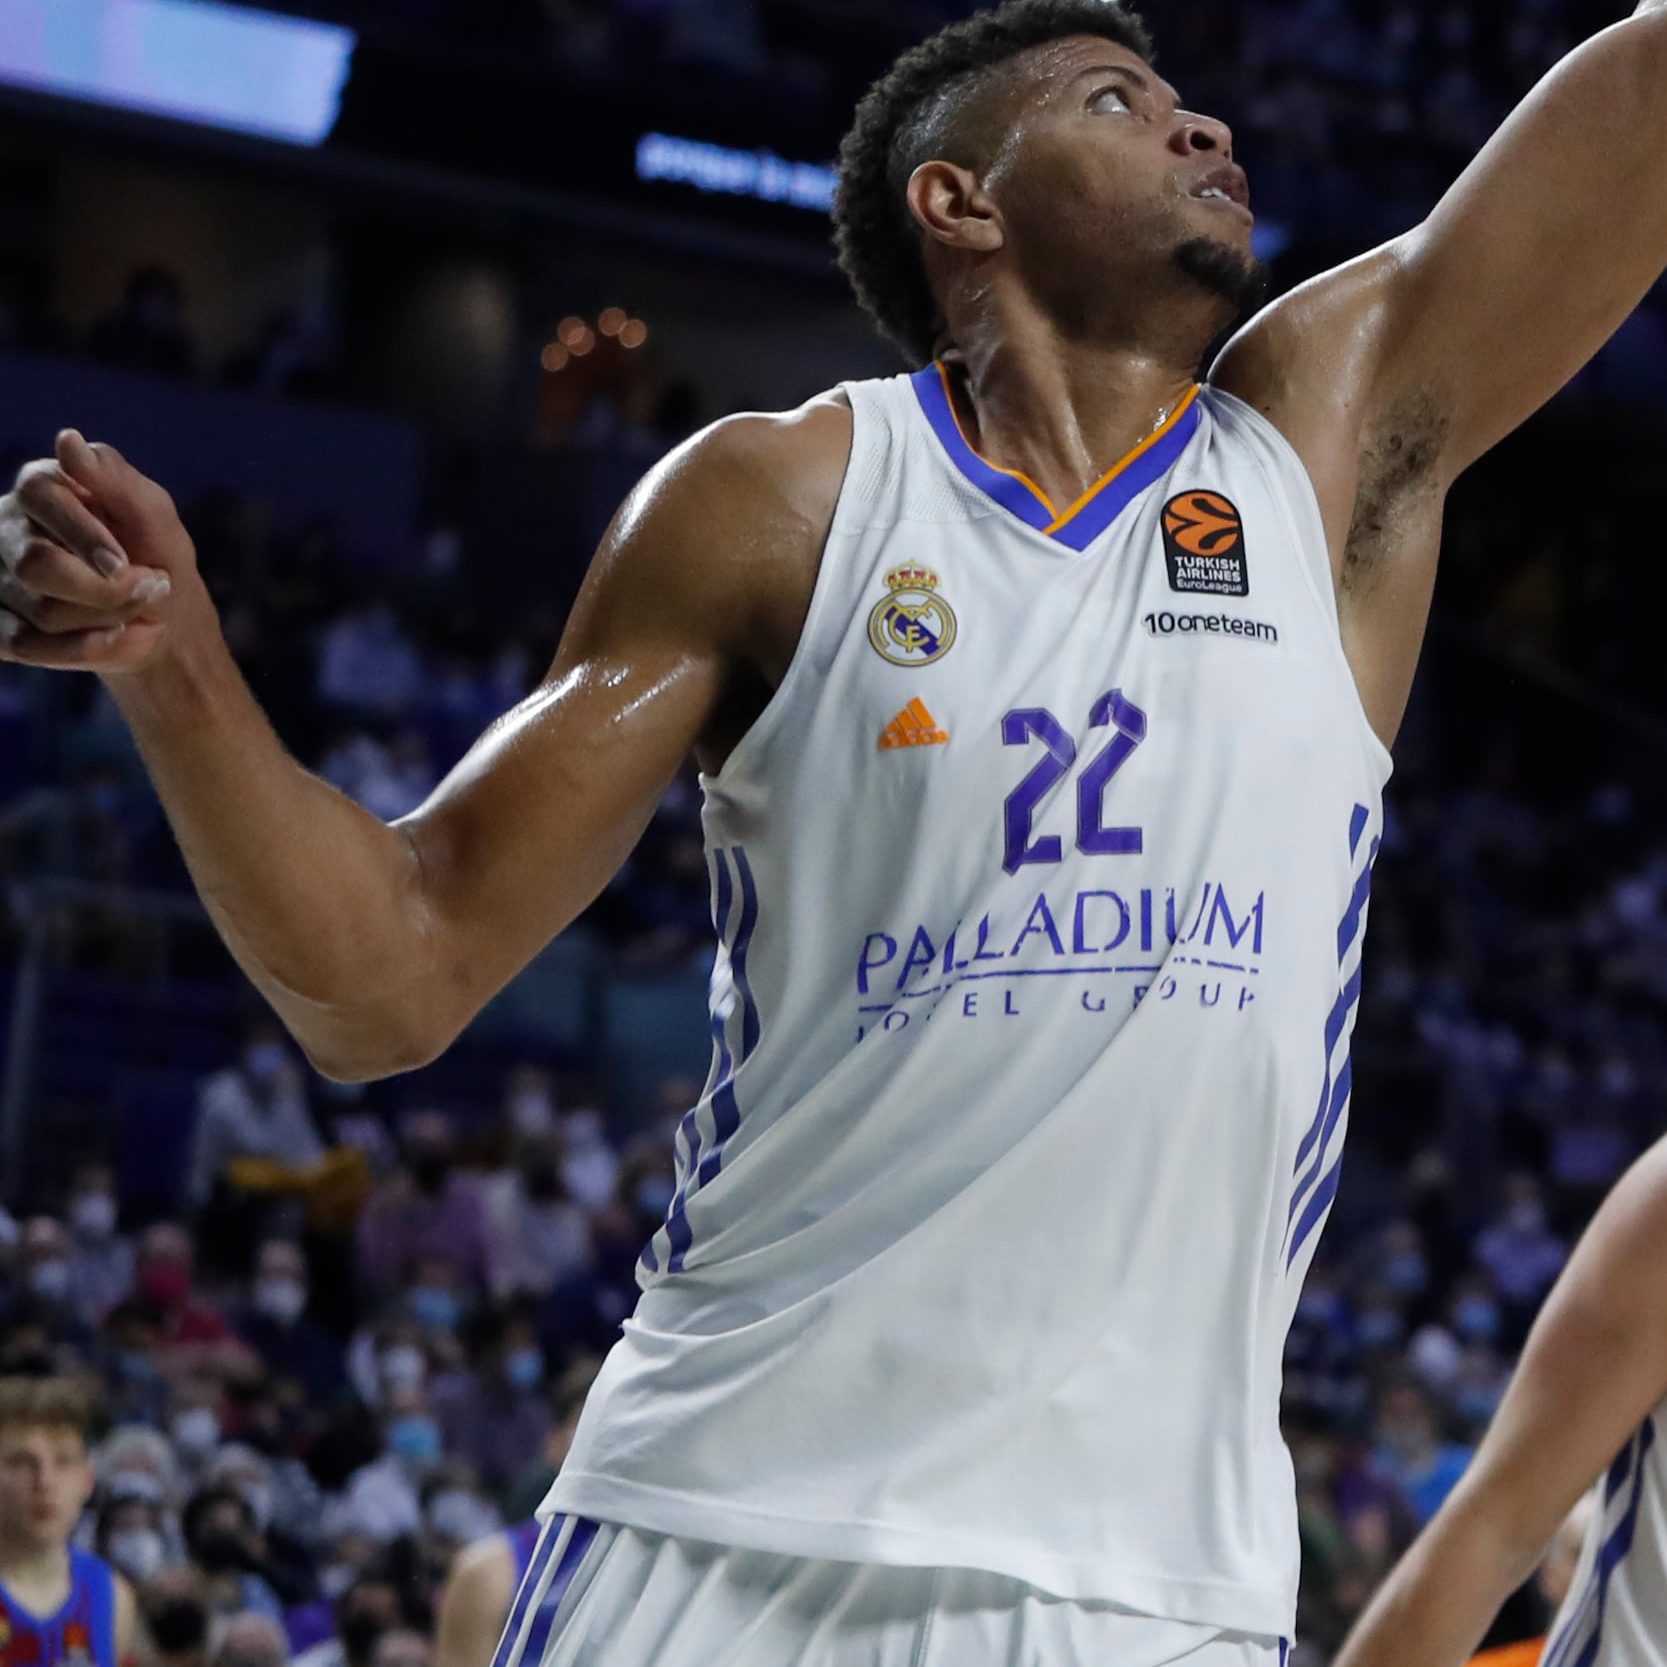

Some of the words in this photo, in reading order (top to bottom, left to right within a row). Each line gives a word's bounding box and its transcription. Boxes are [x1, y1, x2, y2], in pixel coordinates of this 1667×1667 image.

[1174, 556, 1240, 571] TURKISH
[1175, 568, 1242, 583] AIRLINES
[1176, 579, 1243, 594] EuroLeague
[1001, 687, 1148, 876] 22
[856, 881, 1266, 995] PALLADIUM
